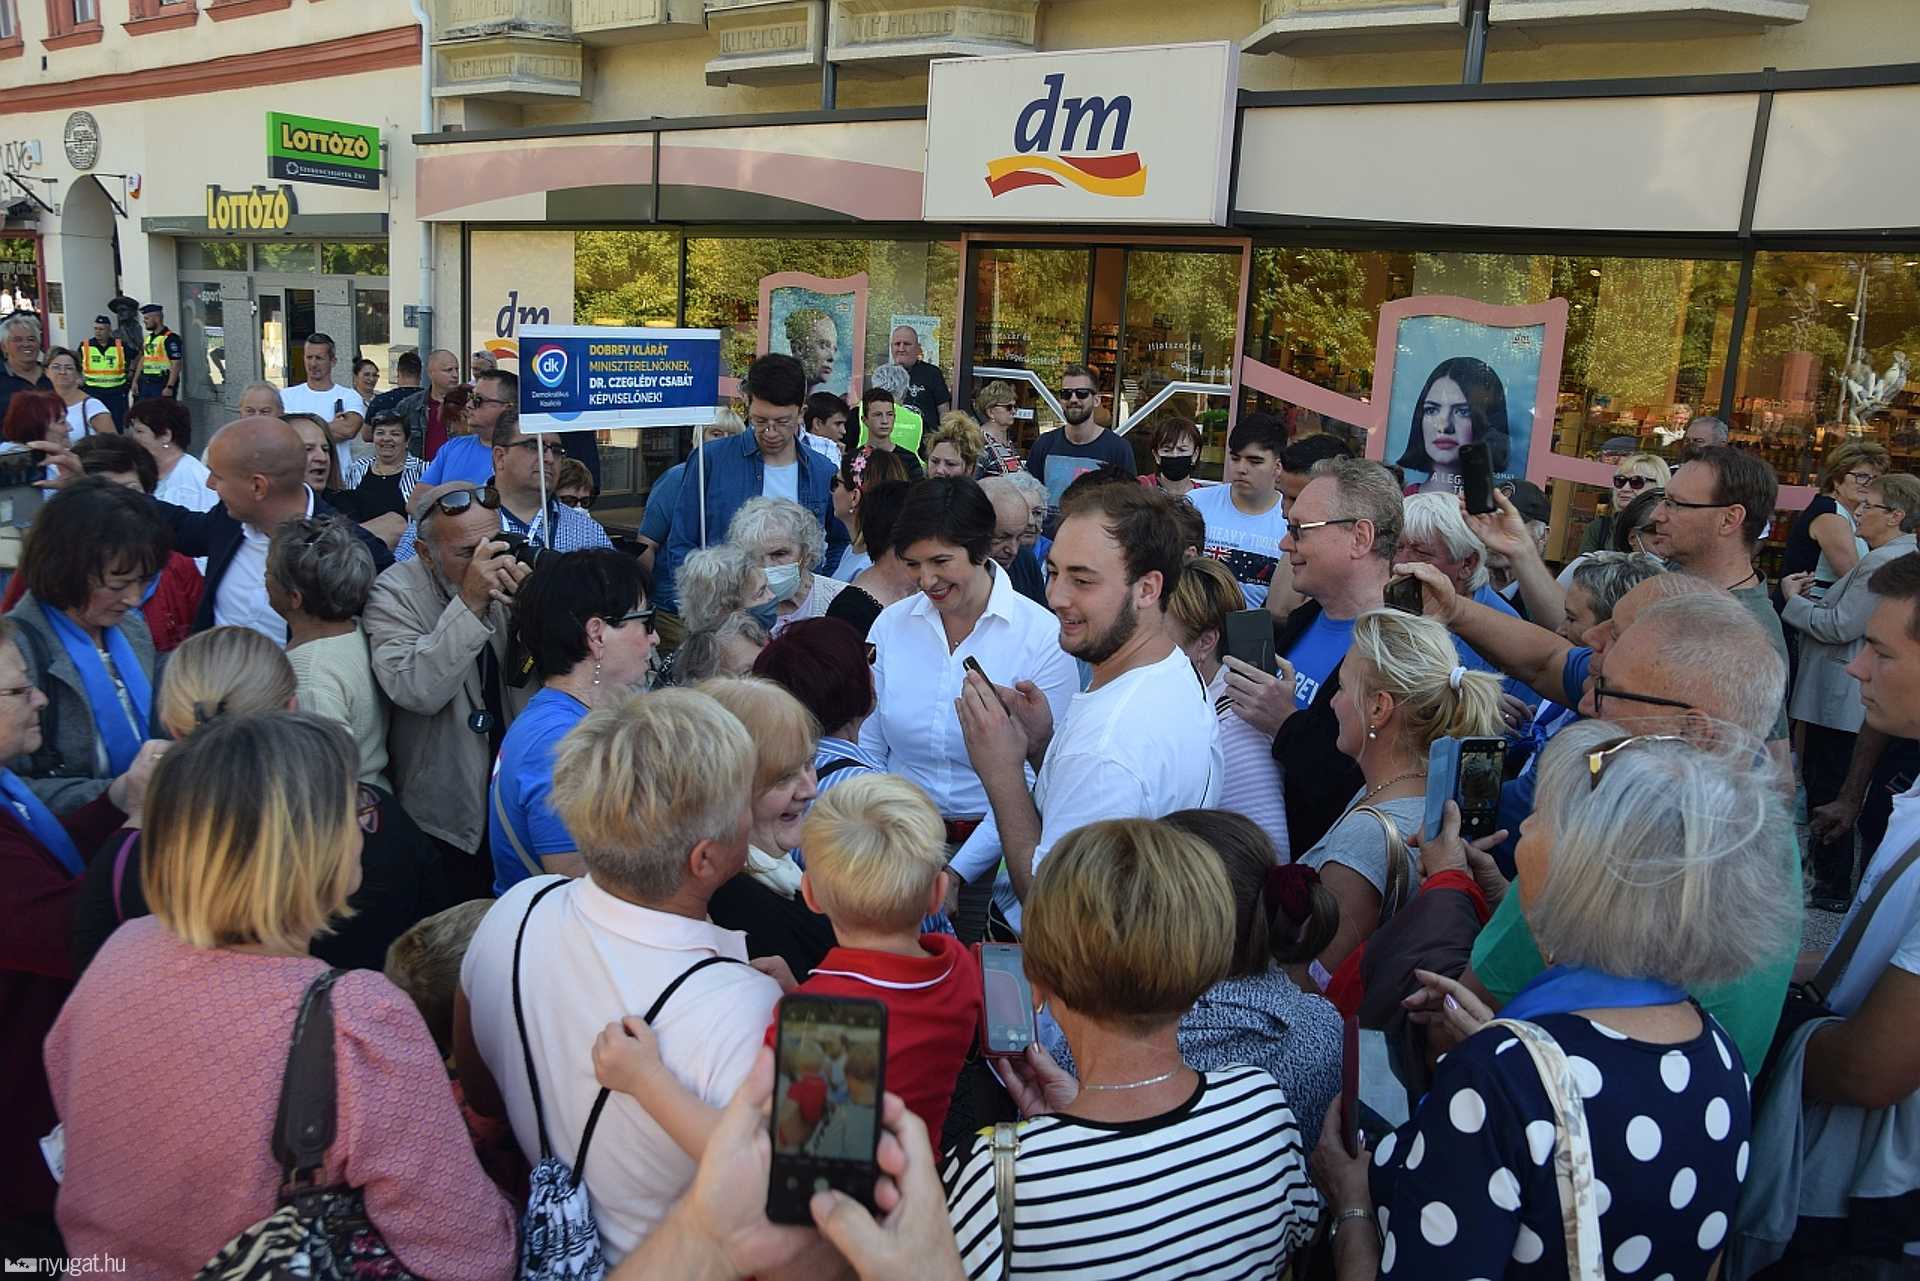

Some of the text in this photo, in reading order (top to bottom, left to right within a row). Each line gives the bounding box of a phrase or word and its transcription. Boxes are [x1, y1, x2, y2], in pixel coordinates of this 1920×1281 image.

[1014, 73, 1132, 154] dm
[282, 123, 370, 159] LOTTÓZÓ
[207, 187, 289, 229] LOTTÓZÓ
[589, 343, 668, 356] DOBREV KLÁRÁT
[543, 358, 559, 373] dk
[589, 373, 693, 389] DR. CZEGLÉDY CSABÁT
[589, 391, 662, 405] KÉPVISELŐNEK!
